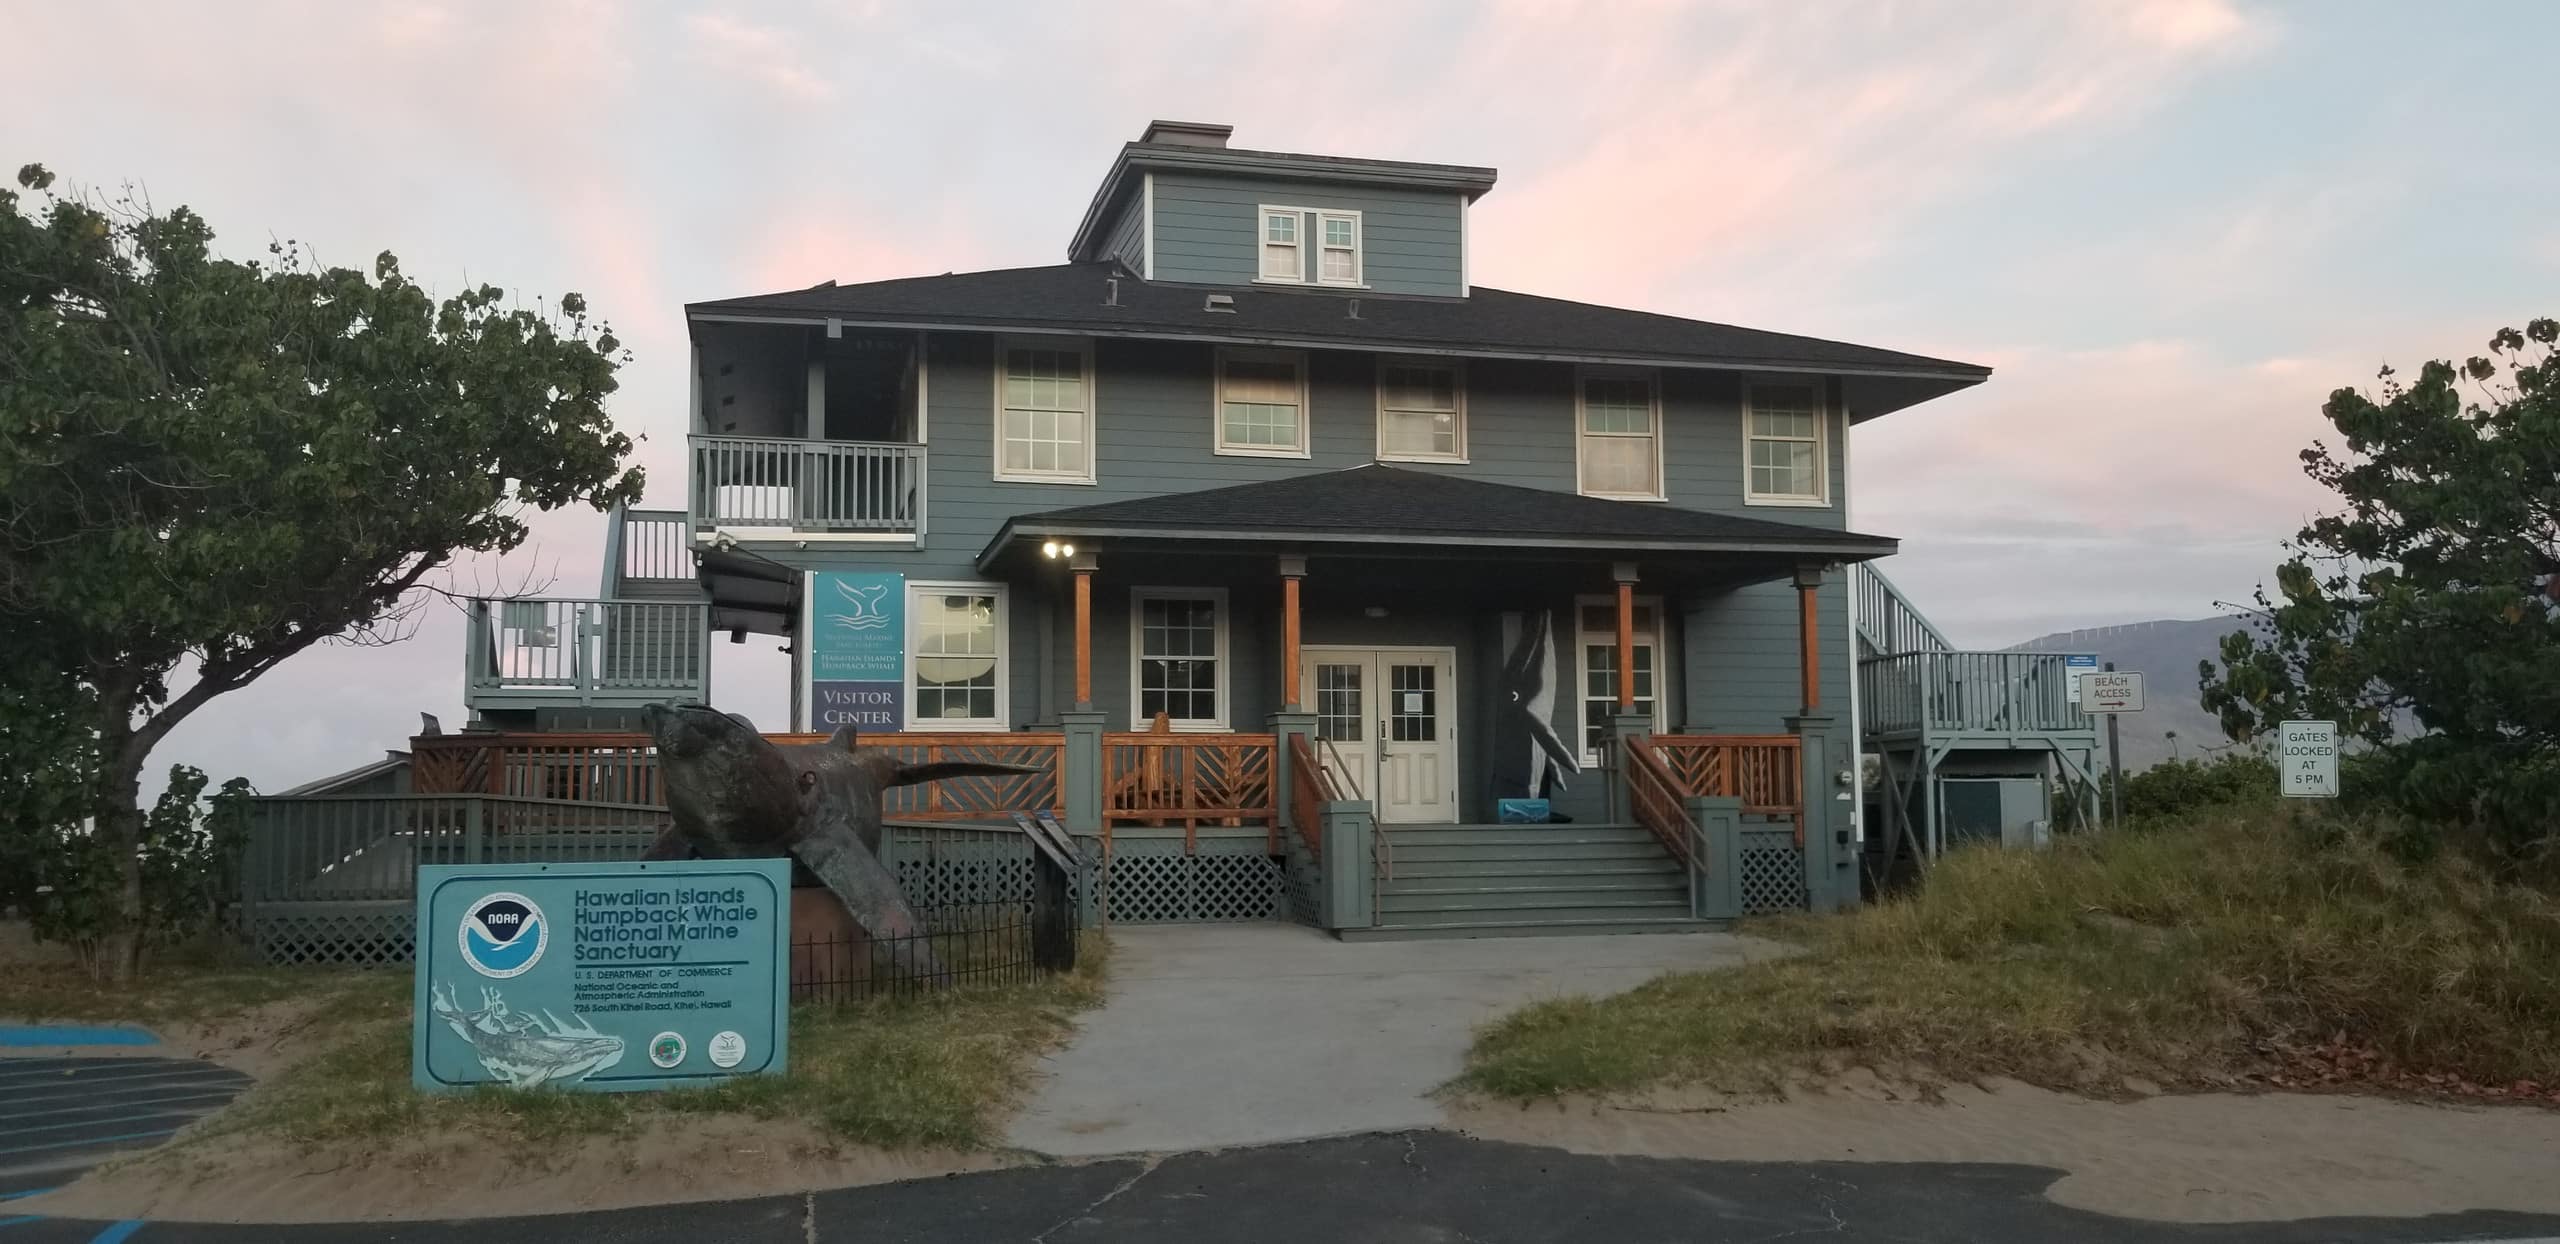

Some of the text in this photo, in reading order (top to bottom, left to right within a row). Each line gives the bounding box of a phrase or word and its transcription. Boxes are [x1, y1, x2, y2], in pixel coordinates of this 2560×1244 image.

[2095, 677, 2128, 687] BEACH
[823, 690, 893, 704] VISITOR
[2094, 689, 2131, 698] ACCESS
[824, 710, 893, 724] CENTER
[2289, 732, 2329, 742] GATES
[2284, 746, 2333, 756] LOCKED
[2302, 760, 2317, 770] AT
[2295, 774, 2324, 784] 5 PM
[575, 888, 745, 907] Hawaiian Islands
[488, 913, 519, 925] NOAA
[574, 905, 758, 926] Humpback Whale
[574, 923, 738, 943] National Marine
[574, 942, 682, 961] Sanctuary
[597, 969, 653, 979] DEPARTMENT
[659, 969, 673, 977] OF
[678, 967, 733, 977] COMMERCE
[574, 981, 679, 992] National Oceanic and
[574, 990, 705, 1002] Atmospheric Administration
[574, 1004, 590, 1013] 726
[592, 1003, 619, 1012] South
